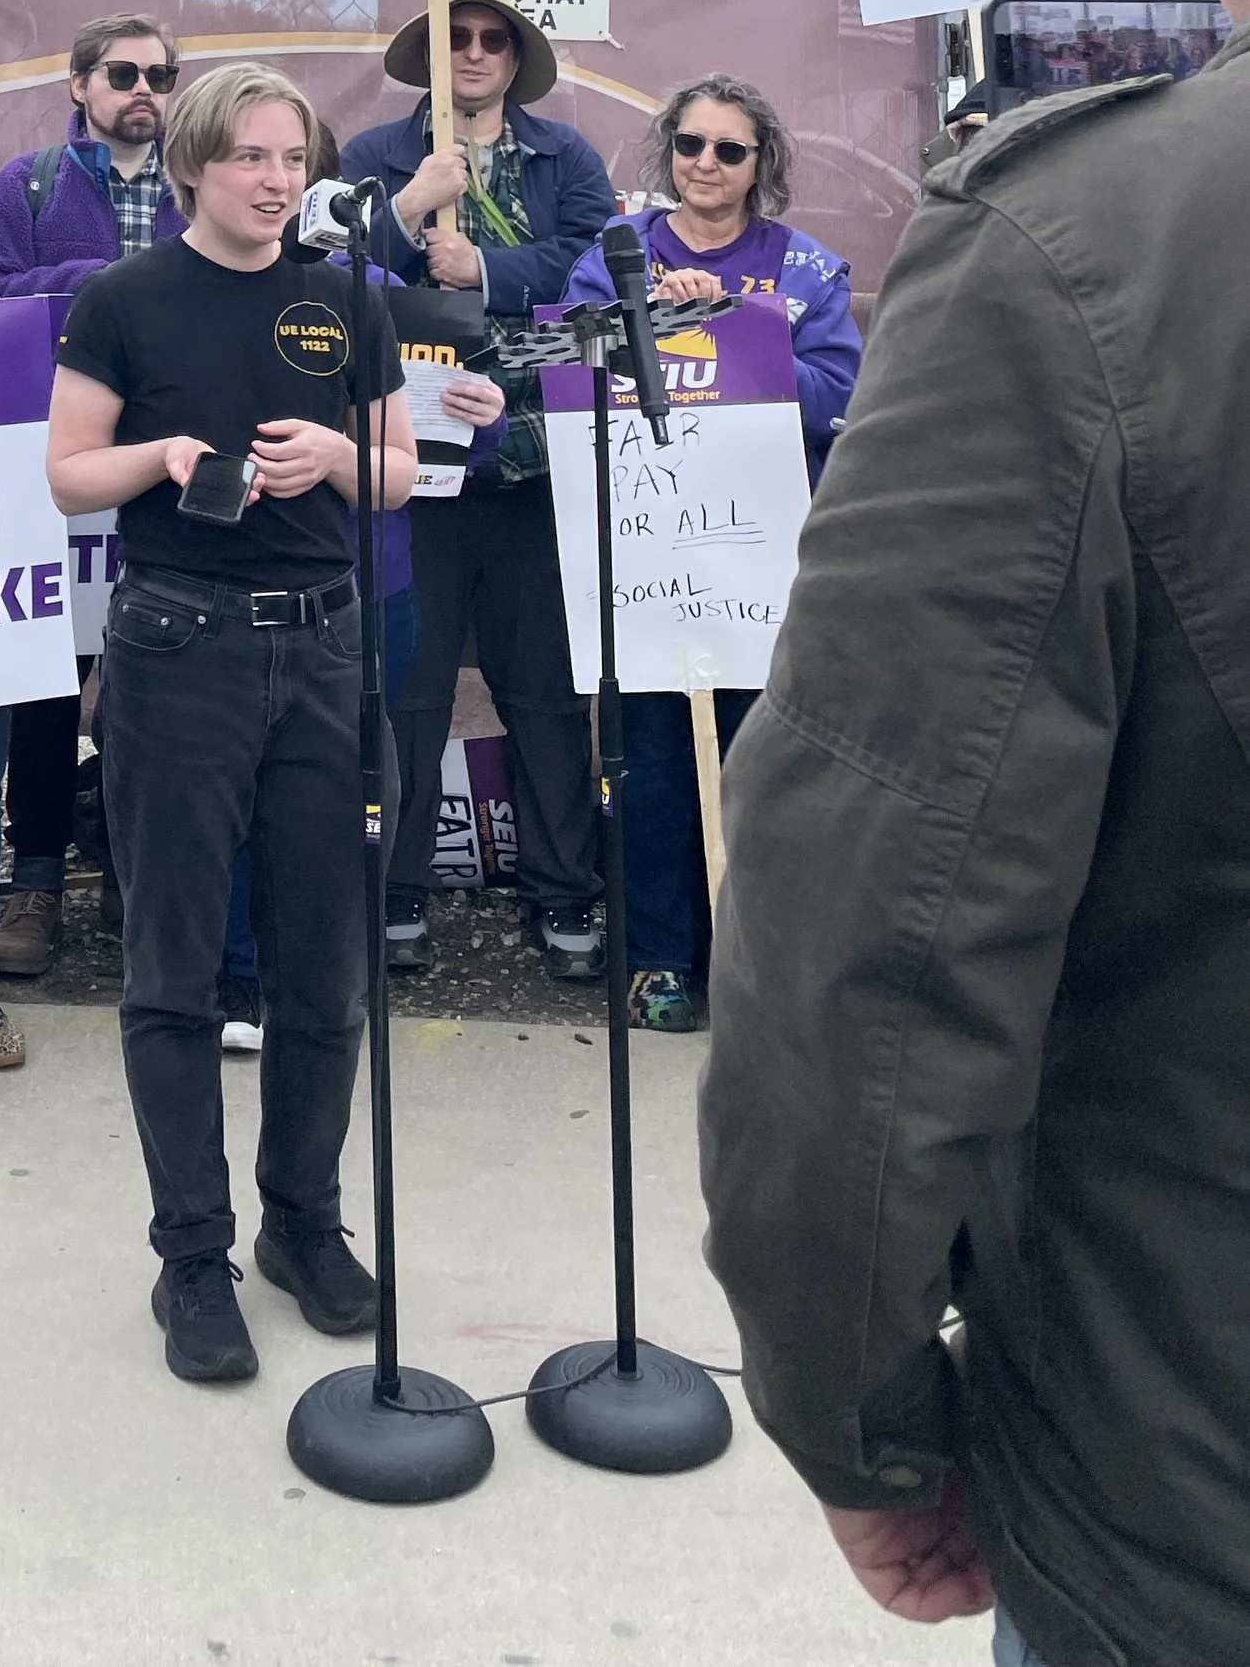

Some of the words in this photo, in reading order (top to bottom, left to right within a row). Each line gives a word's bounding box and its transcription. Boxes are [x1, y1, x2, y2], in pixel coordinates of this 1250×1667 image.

[740, 275, 776, 294] 73
[280, 326, 299, 336] UE
[301, 325, 344, 340] LOCAL
[300, 340, 330, 352] 1122
[611, 360, 717, 393] SIU
[668, 390, 720, 404] Together
[610, 459, 684, 502] PAY
[613, 512, 655, 536] OR
[677, 499, 758, 535] ALL
[612, 573, 714, 608] SOCIAL
[672, 599, 784, 624] JUSTICE
[488, 798, 520, 874] SEIU
